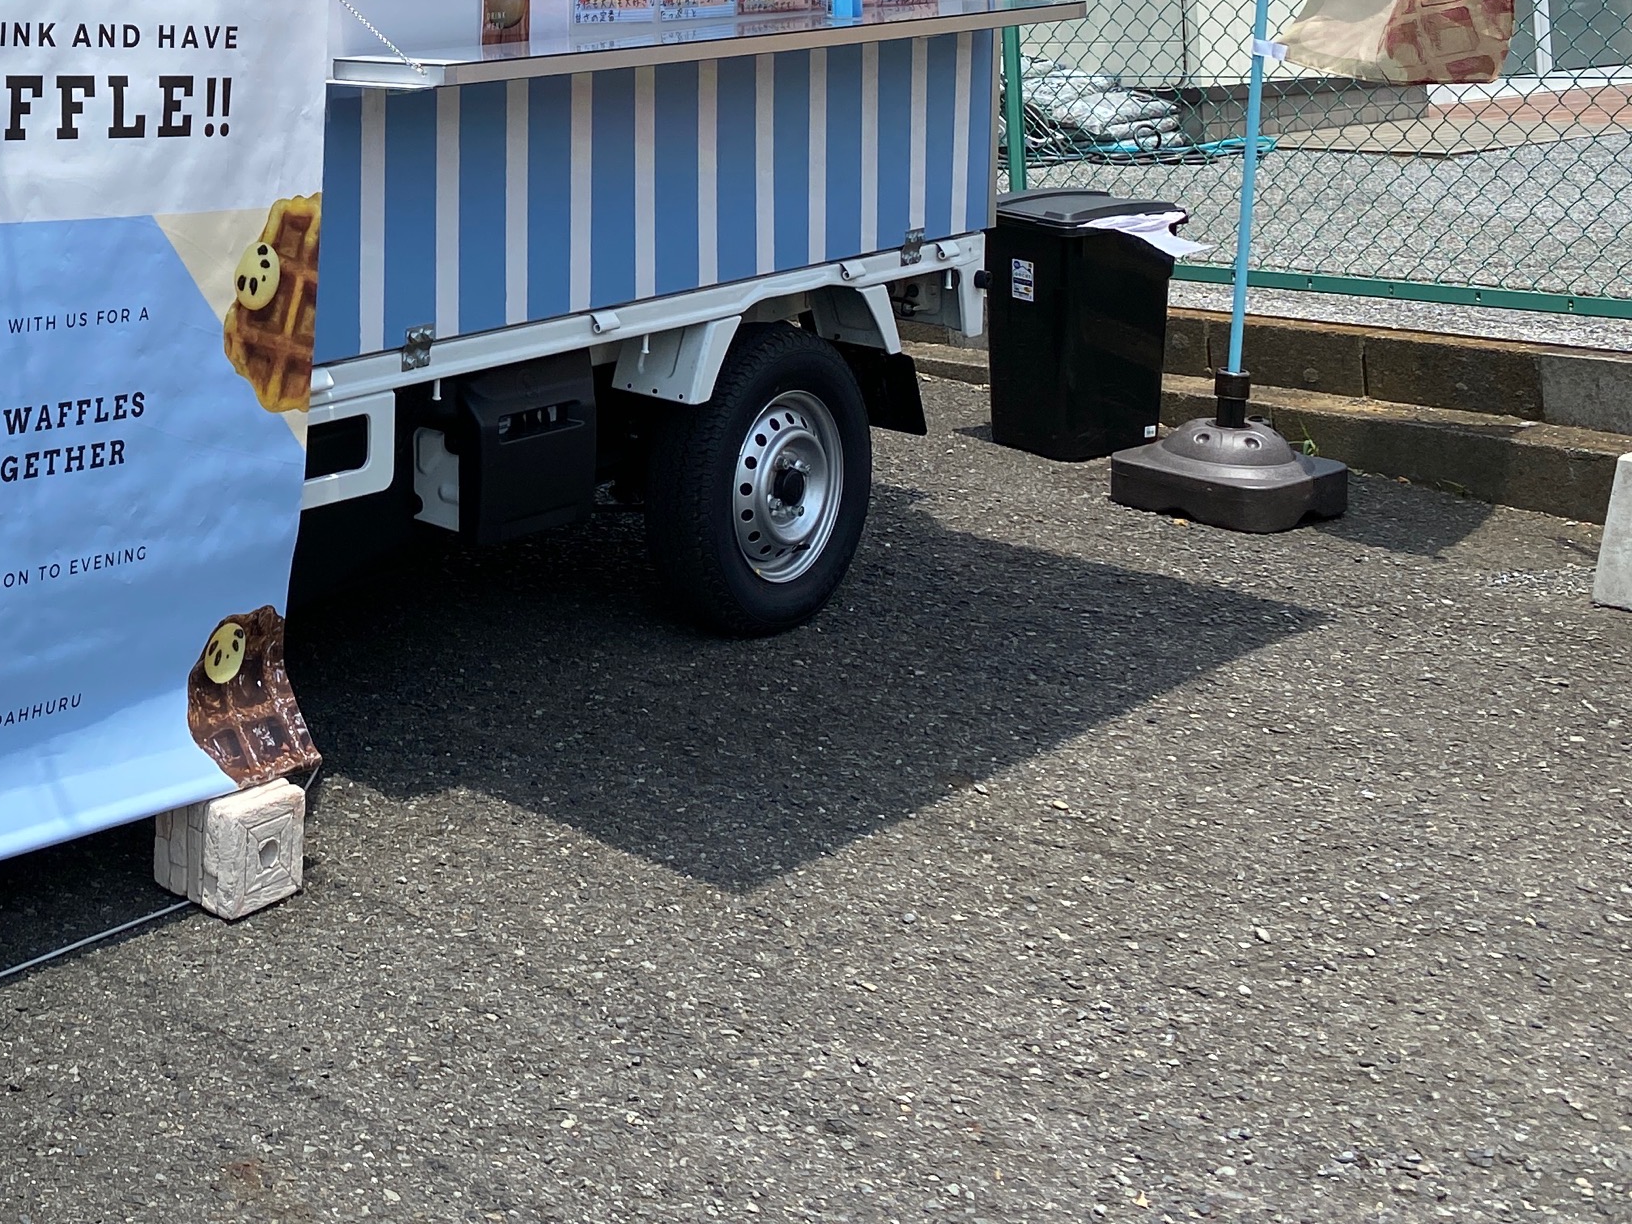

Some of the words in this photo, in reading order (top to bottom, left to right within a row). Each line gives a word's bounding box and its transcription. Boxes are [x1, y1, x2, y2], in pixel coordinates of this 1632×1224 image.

[71, 23, 141, 48] AND
[157, 24, 239, 49] HAVE
[7, 312, 57, 336] WITH
[65, 311, 89, 329] US
[95, 307, 131, 327] FOR
[138, 305, 151, 323] A
[3, 391, 146, 436] WAFFLES
[38, 562, 62, 582] TO
[69, 544, 148, 578] EVENING
